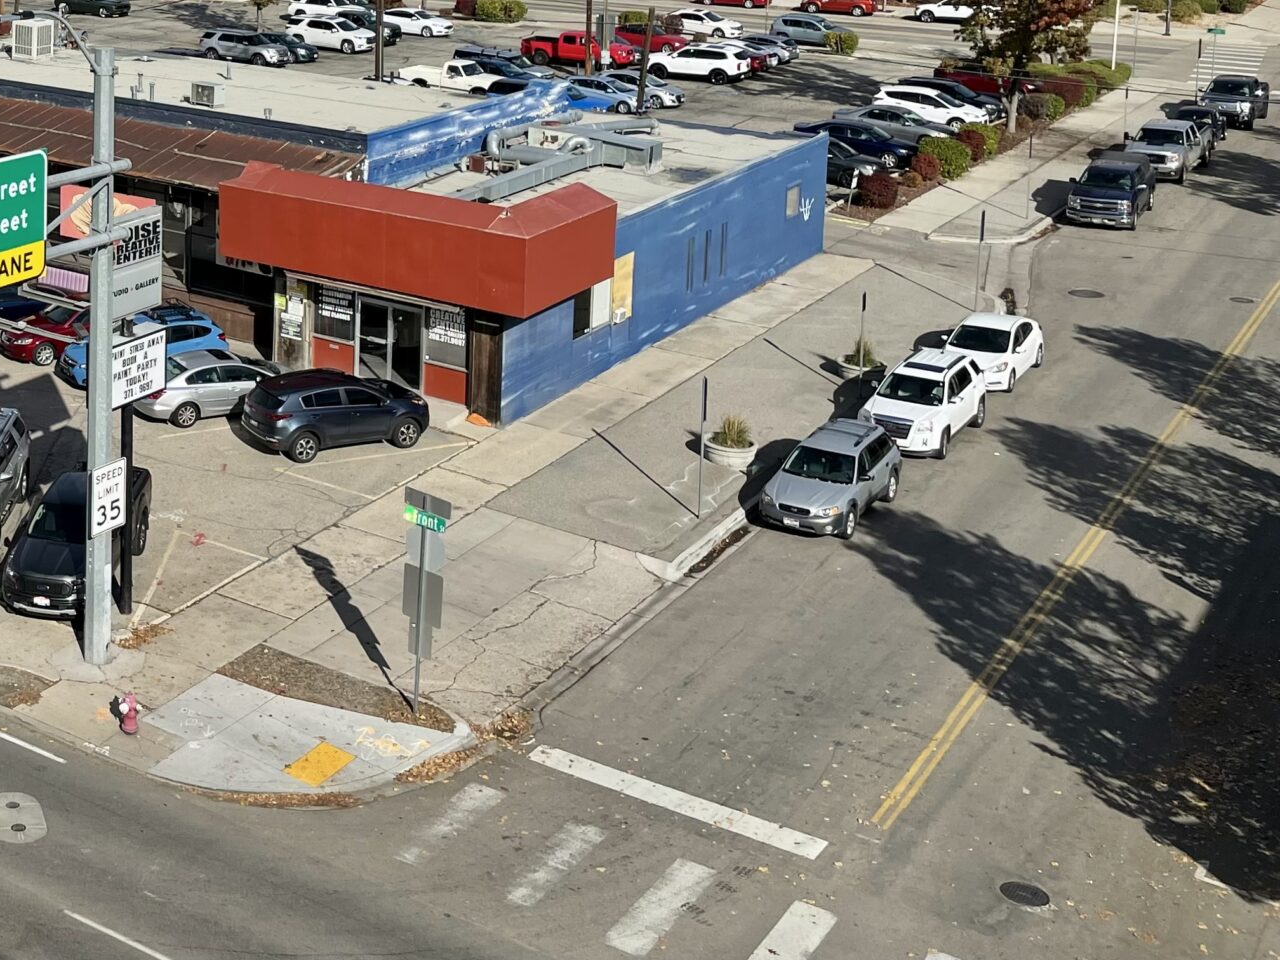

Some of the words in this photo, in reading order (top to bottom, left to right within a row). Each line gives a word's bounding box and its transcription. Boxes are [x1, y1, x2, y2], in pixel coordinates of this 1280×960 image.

[116, 234, 160, 256] REATIVE
[113, 243, 160, 266] ENTER!!
[135, 277, 160, 291] GALLERY
[430, 309, 465, 325] CREATIVE
[130, 342, 145, 354] STRESS
[147, 335, 164, 348] AWAY
[122, 355, 137, 368] BOOK
[143, 351, 148, 360] A
[113, 367, 131, 382] PAINT
[137, 358, 157, 373] PARTY
[125, 372, 149, 388] TODAY!
[95, 466, 123, 485] SPEED
[98, 483, 120, 500] LIMIT
[96, 498, 121, 526] 35
[417, 513, 438, 531] ront
